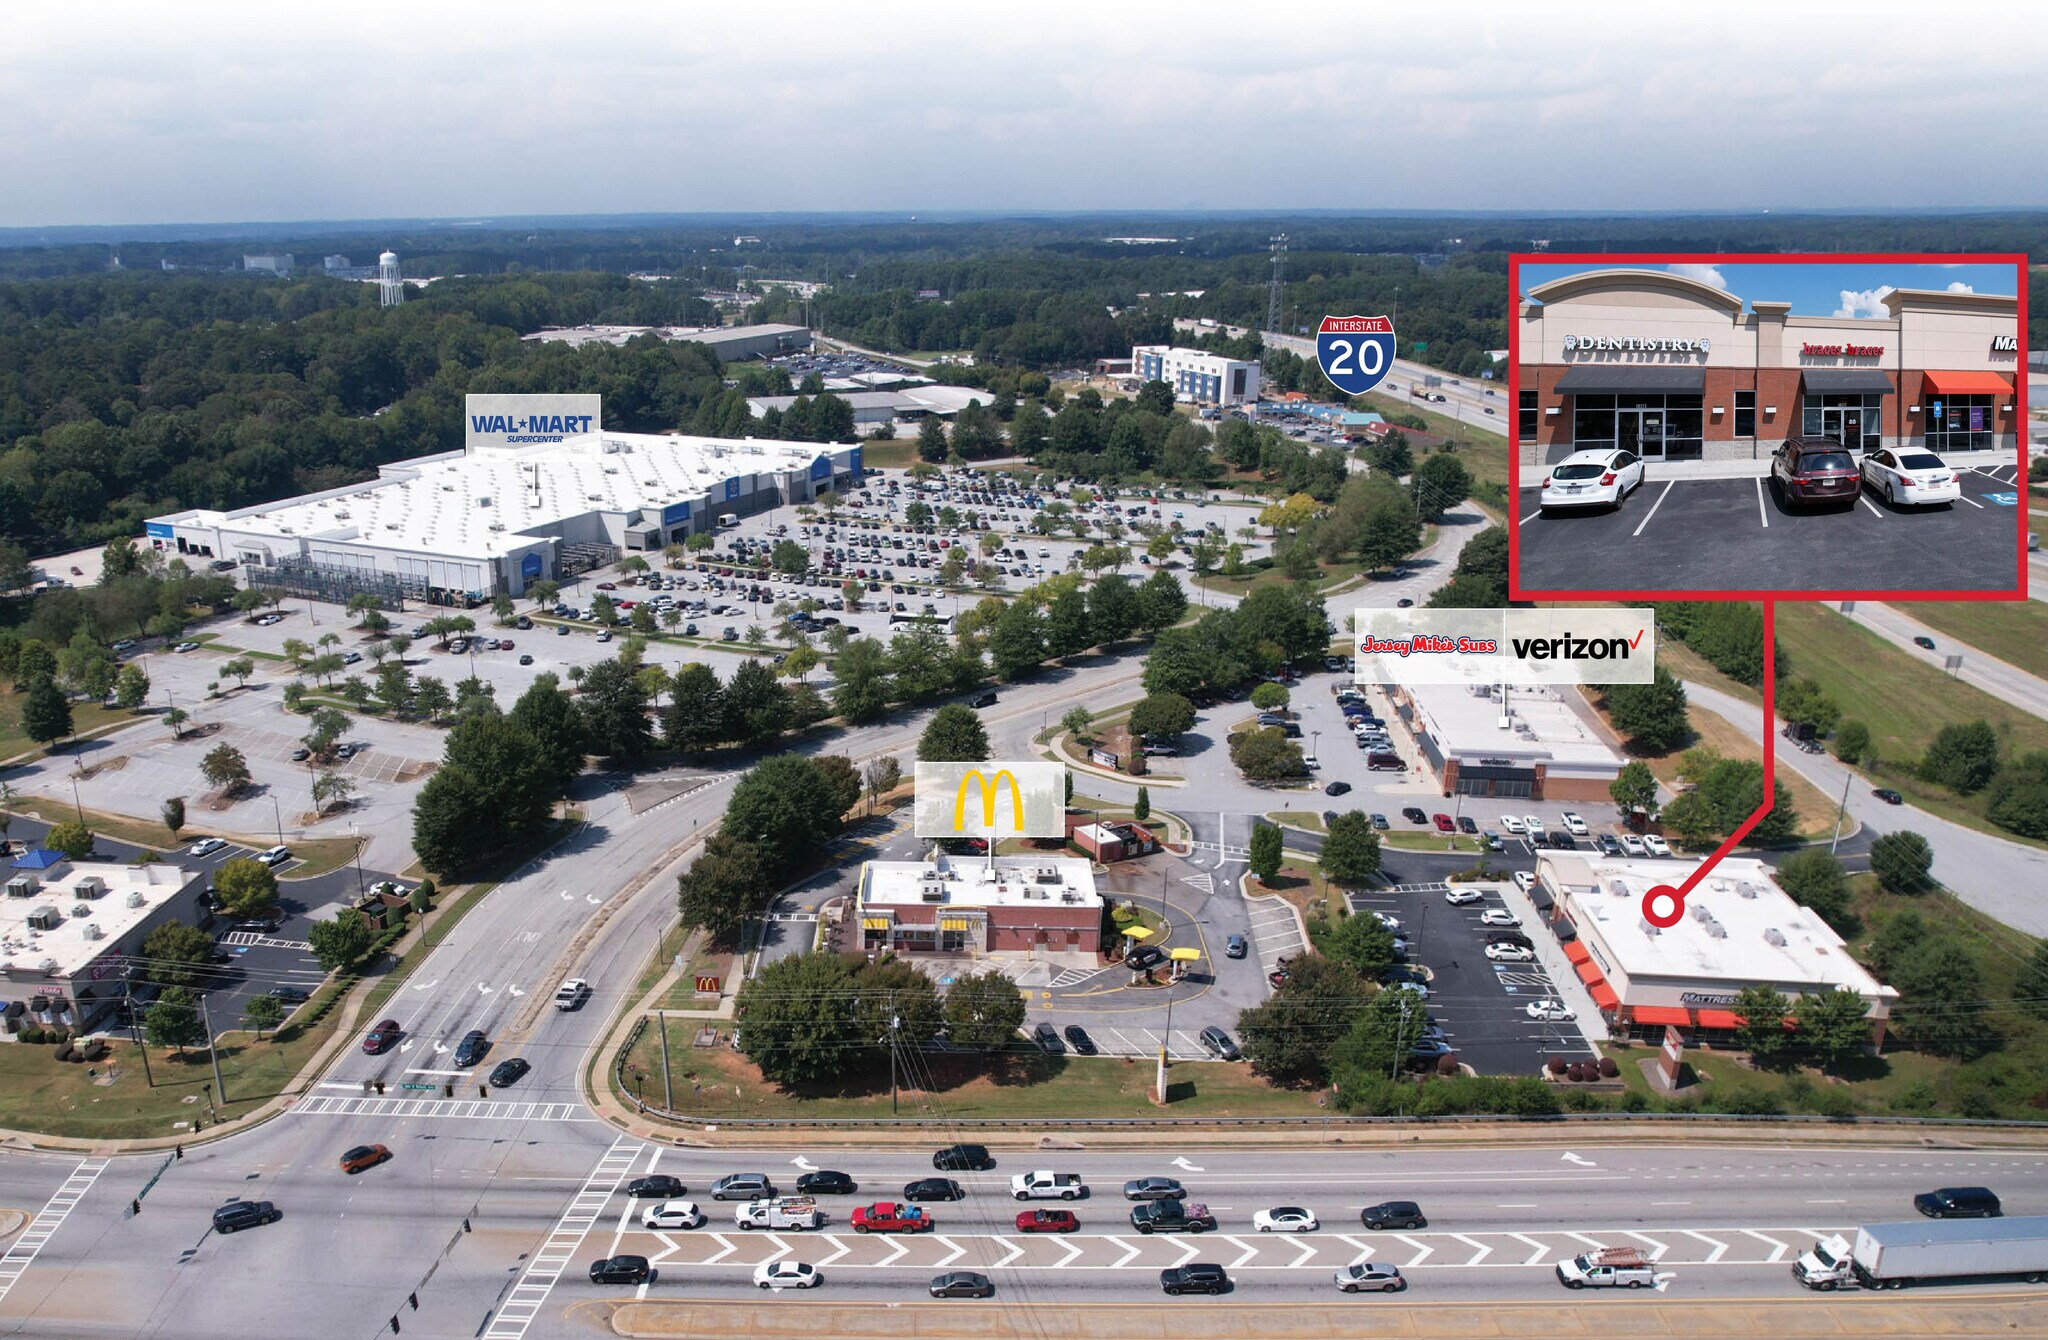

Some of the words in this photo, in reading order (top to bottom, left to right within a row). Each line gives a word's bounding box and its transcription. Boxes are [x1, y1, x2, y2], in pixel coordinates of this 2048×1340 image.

[1578, 335, 1696, 351] DENTISTRY
[1803, 342, 1842, 355] braces
[1847, 343, 1884, 356] braces
